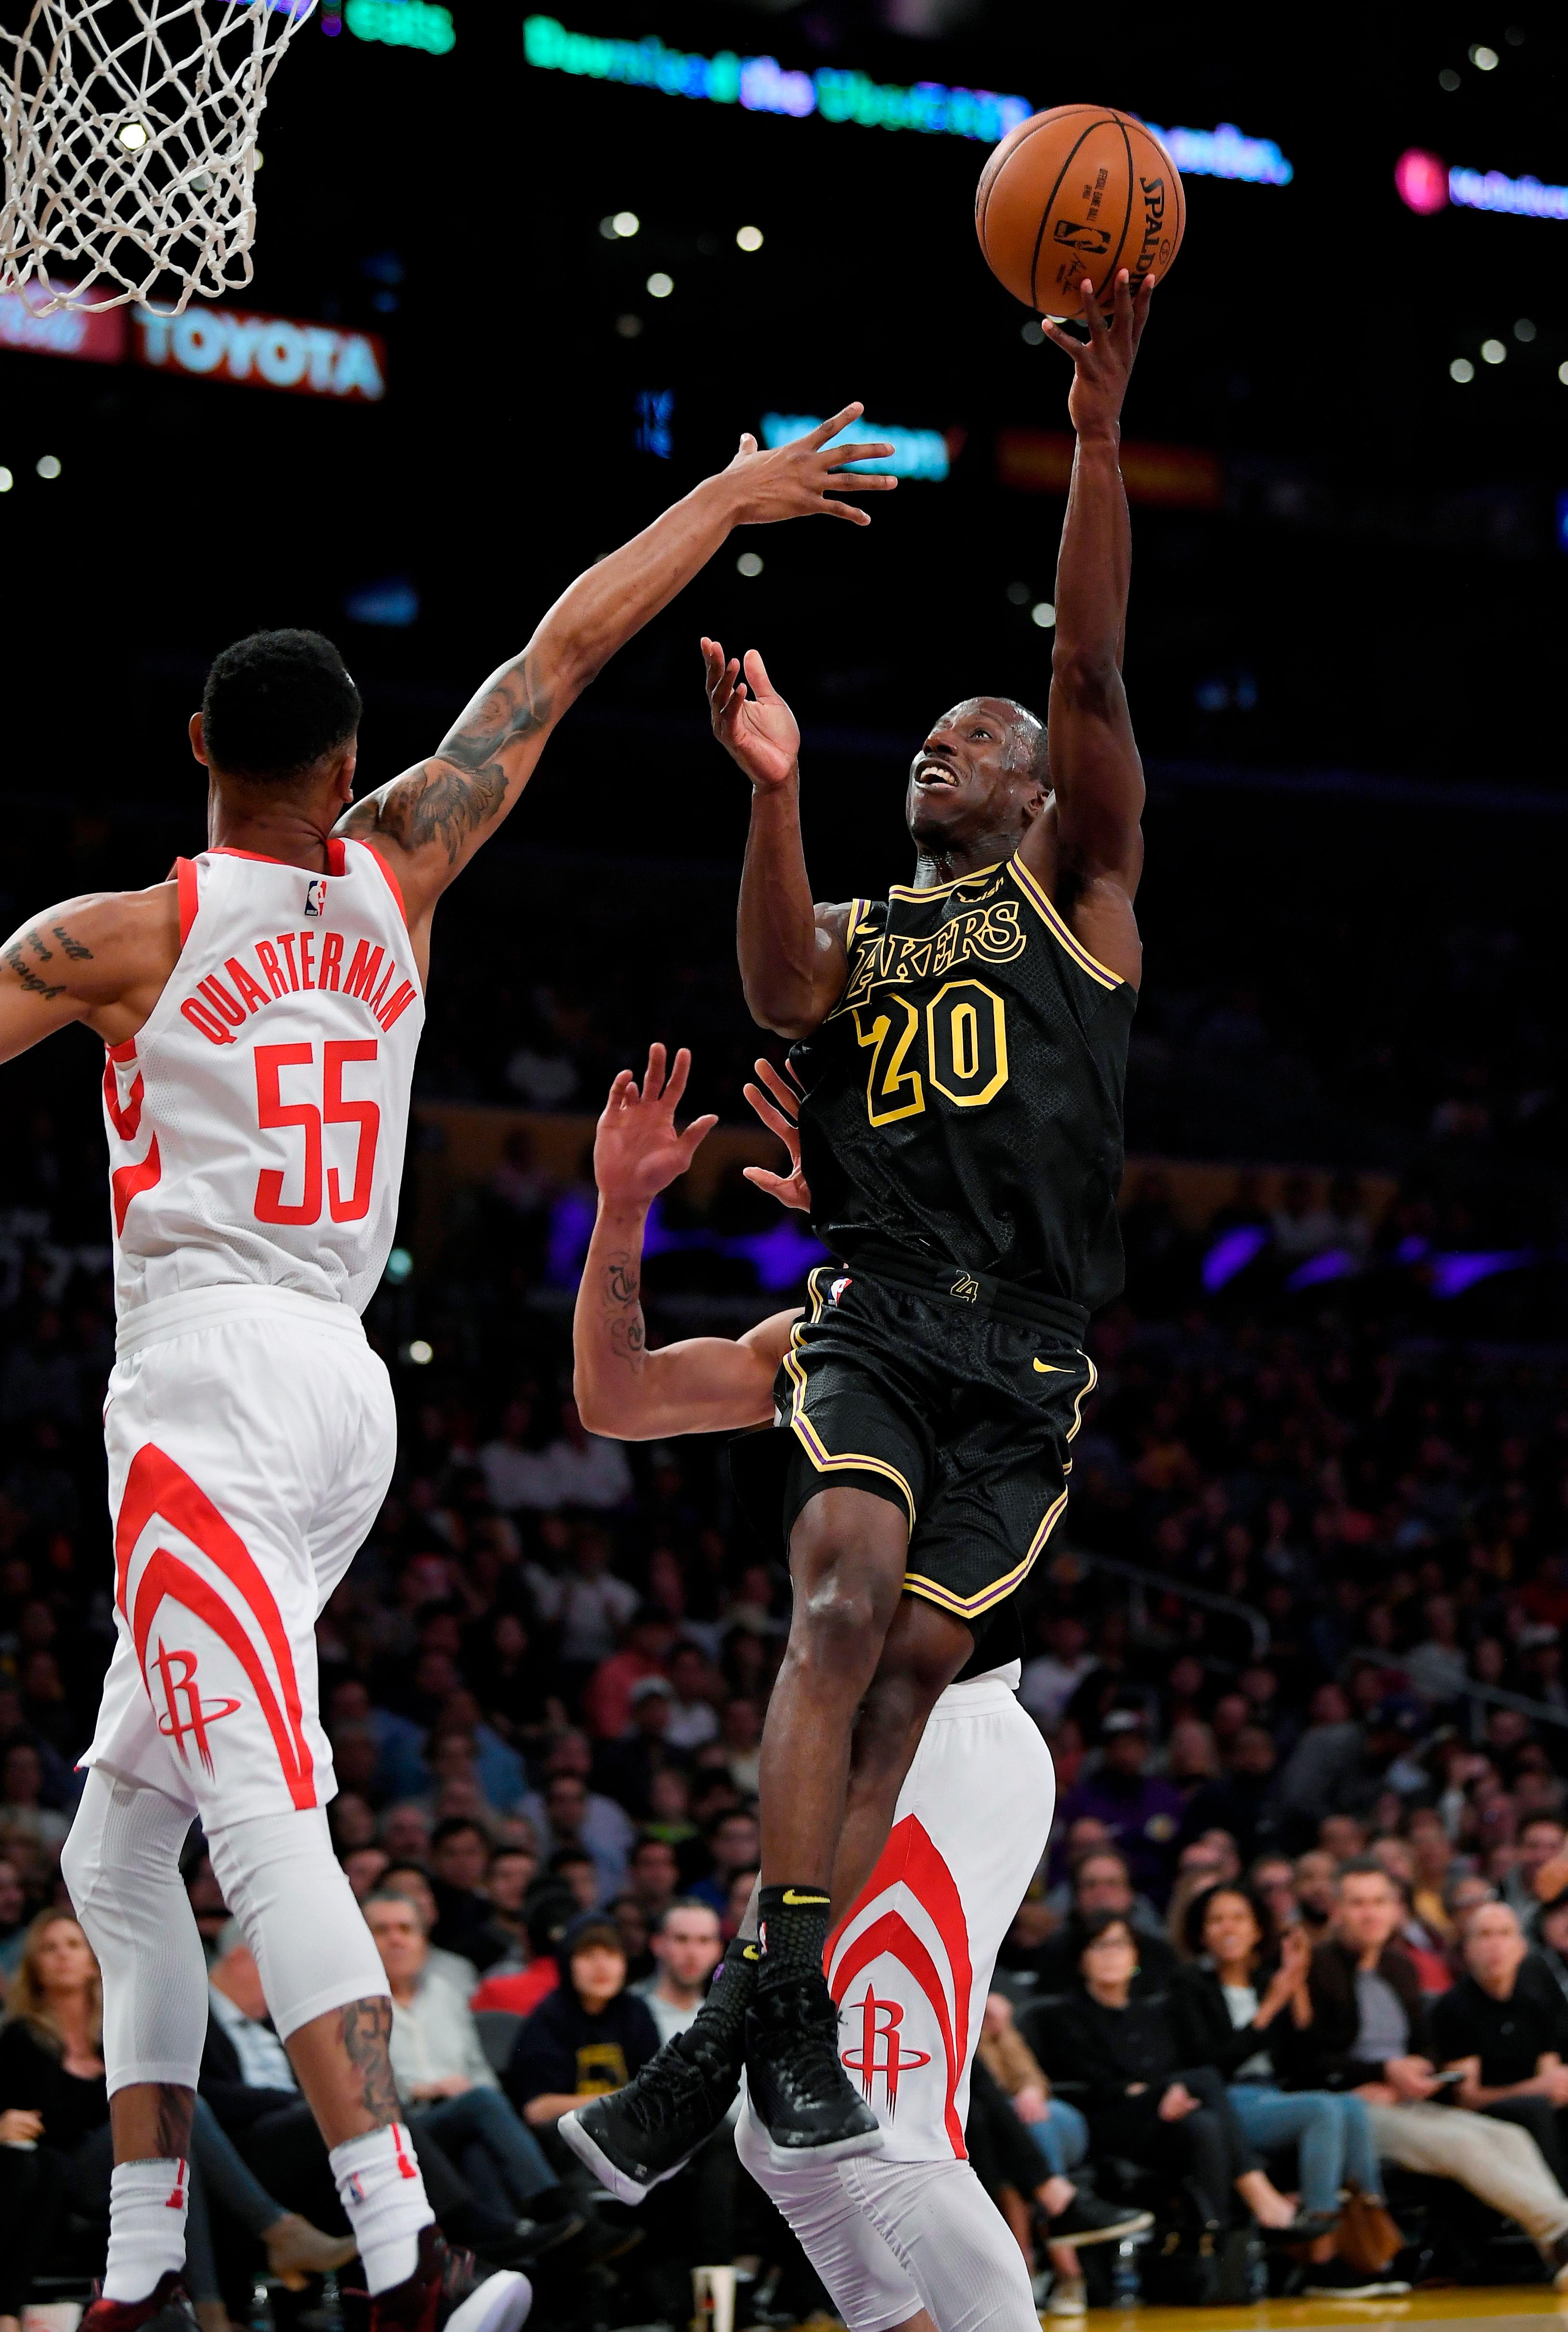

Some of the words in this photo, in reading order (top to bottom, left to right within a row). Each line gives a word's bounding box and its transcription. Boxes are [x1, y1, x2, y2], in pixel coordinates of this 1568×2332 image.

[1129, 177, 1164, 295] SPALDI
[131, 304, 384, 401] TOYOTA
[957, 877, 1004, 903] wish
[180, 932, 418, 1045] QUARTERMAN
[824, 901, 1027, 1022] AKERS
[852, 979, 1009, 1128] 20
[254, 1040, 380, 1225] 55
[950, 1269, 979, 1304] 24
